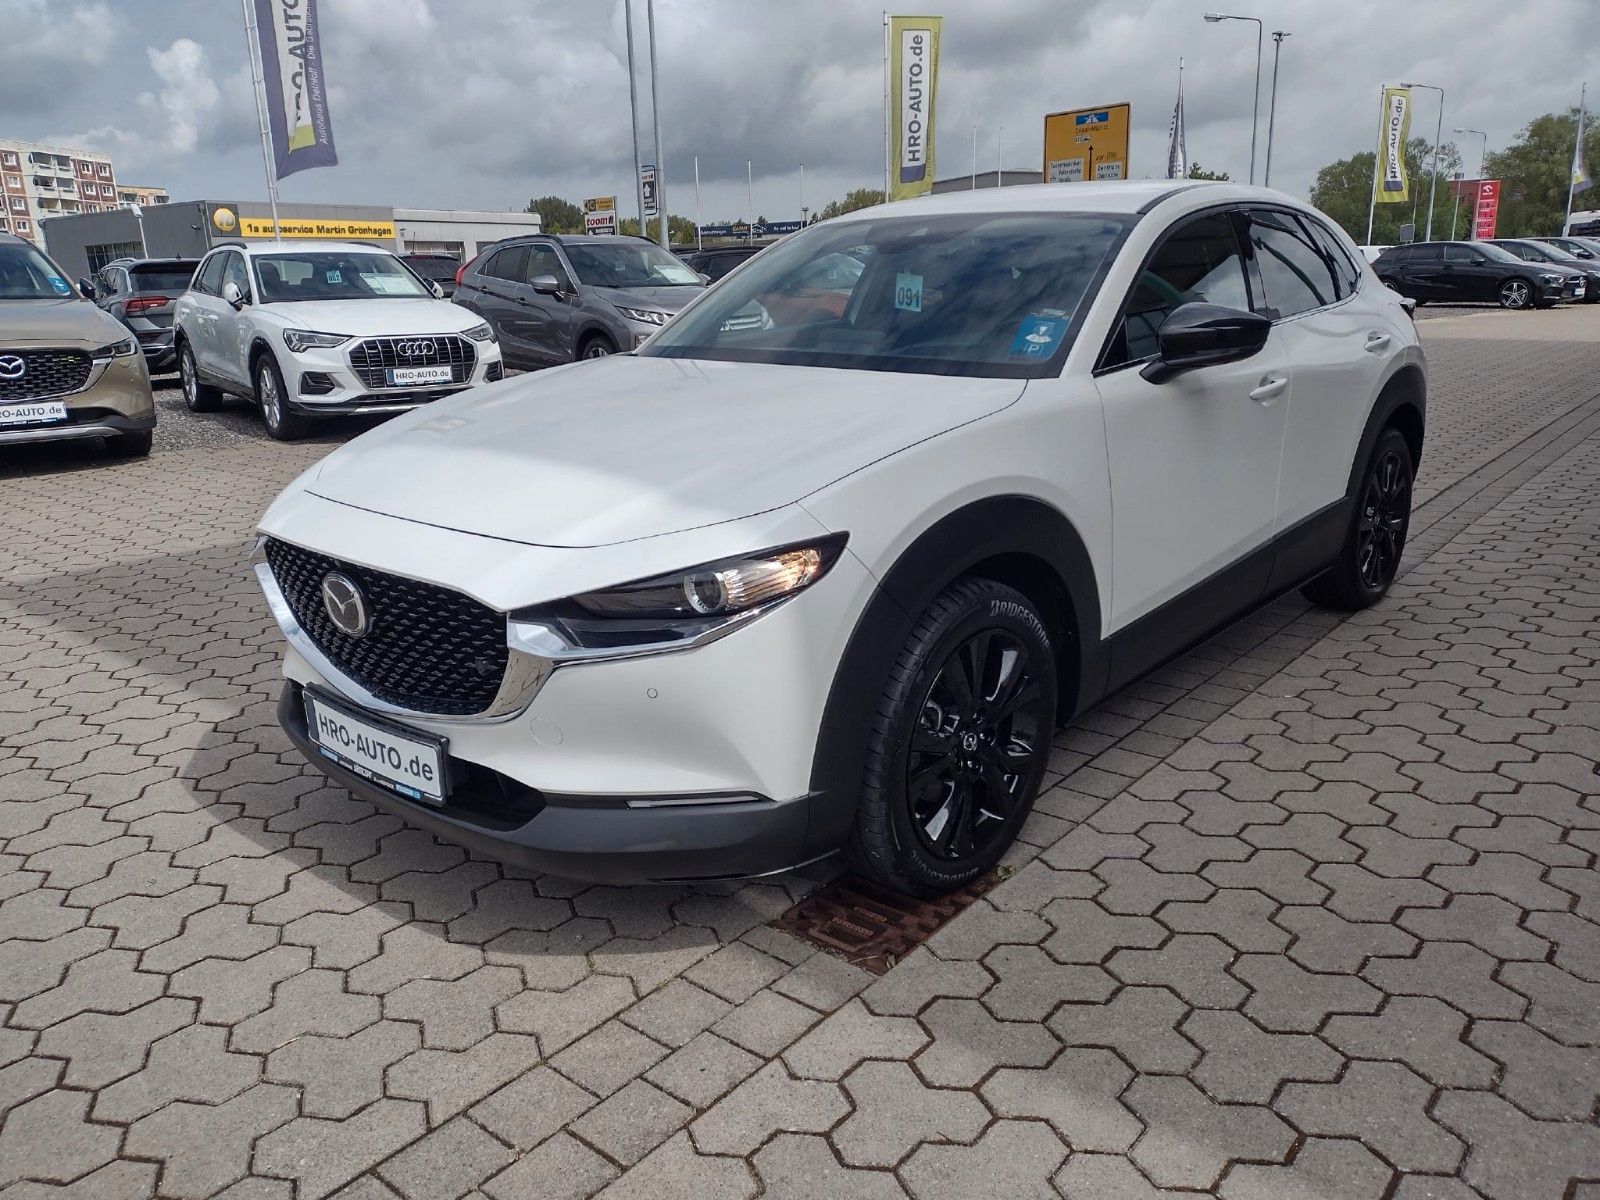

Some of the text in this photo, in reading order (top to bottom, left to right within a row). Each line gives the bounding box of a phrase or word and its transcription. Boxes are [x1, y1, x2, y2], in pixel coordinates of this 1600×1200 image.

[908, 34, 923, 163] HRO-AUTO.de
[247, 224, 259, 233] 1a
[316, 225, 346, 234] Martin
[348, 225, 392, 236] Grönhagen
[586, 216, 608, 227] toom
[898, 287, 920, 308] 091
[318, 713, 434, 782] HRO-AUTO.de
